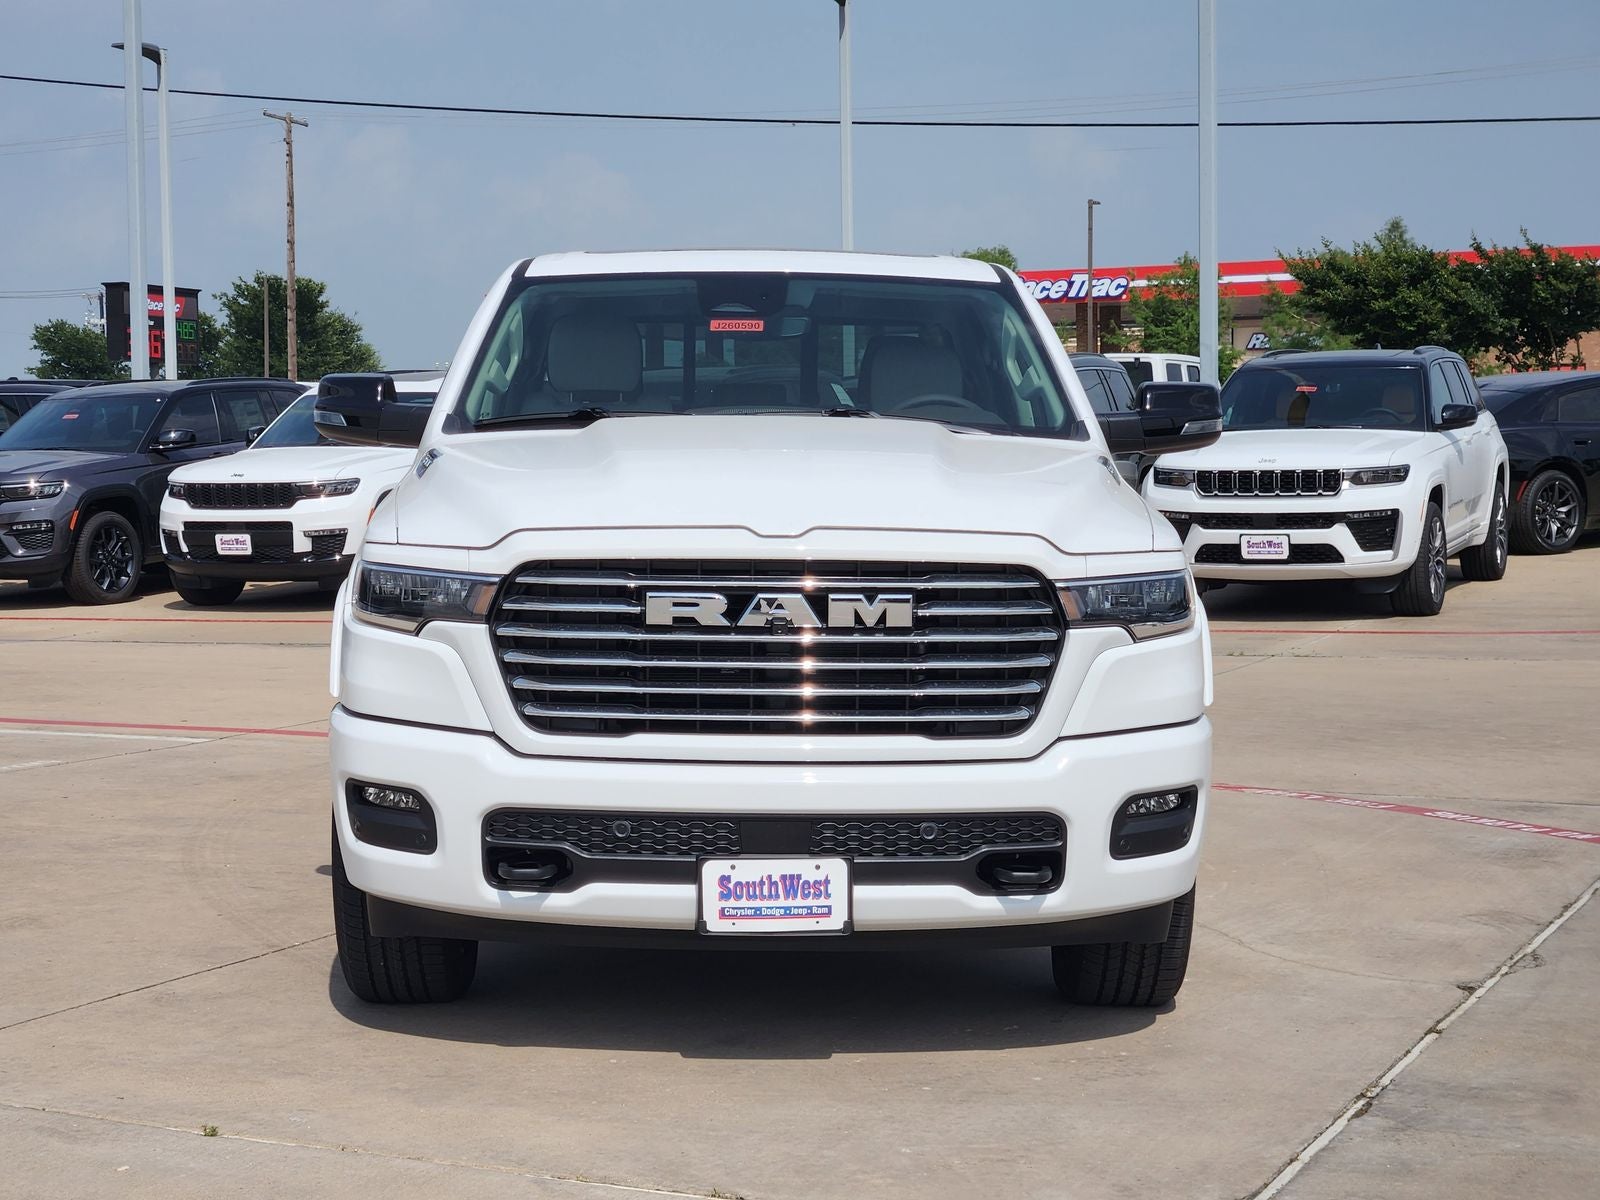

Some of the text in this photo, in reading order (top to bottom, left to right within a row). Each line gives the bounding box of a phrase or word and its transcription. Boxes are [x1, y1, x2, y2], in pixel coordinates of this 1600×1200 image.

[1020, 272, 1128, 300] aceTrac
[714, 321, 760, 330] J260590
[1246, 540, 1283, 549] SouthWest
[645, 591, 913, 628] RAM
[1424, 811, 1552, 833] PARKING
[718, 873, 832, 902] SouthWest
[724, 906, 829, 917] Chrysler Dodge Jeep Ram
